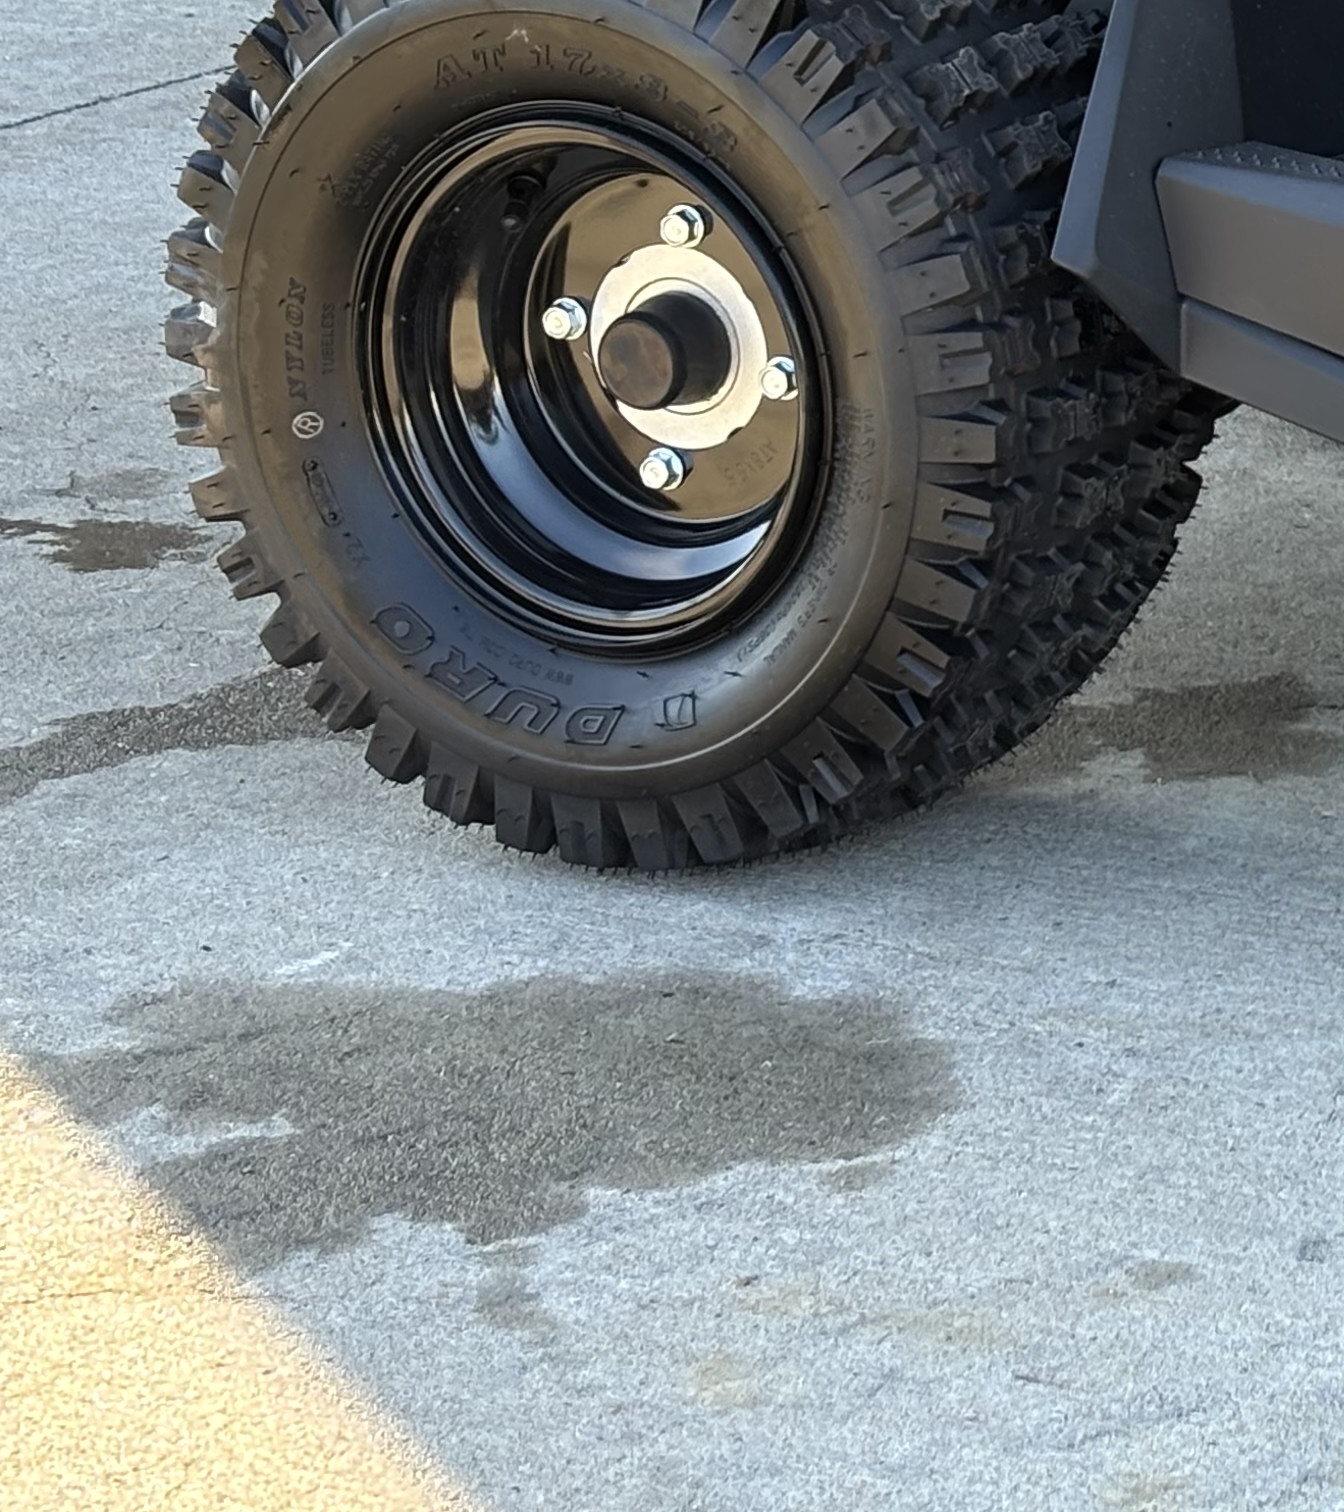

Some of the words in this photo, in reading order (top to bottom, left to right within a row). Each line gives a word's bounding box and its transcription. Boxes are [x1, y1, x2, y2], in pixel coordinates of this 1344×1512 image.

[284, 276, 307, 401] NYLON
[320, 302, 336, 374] TUBELESS
[369, 600, 626, 746] DURO
